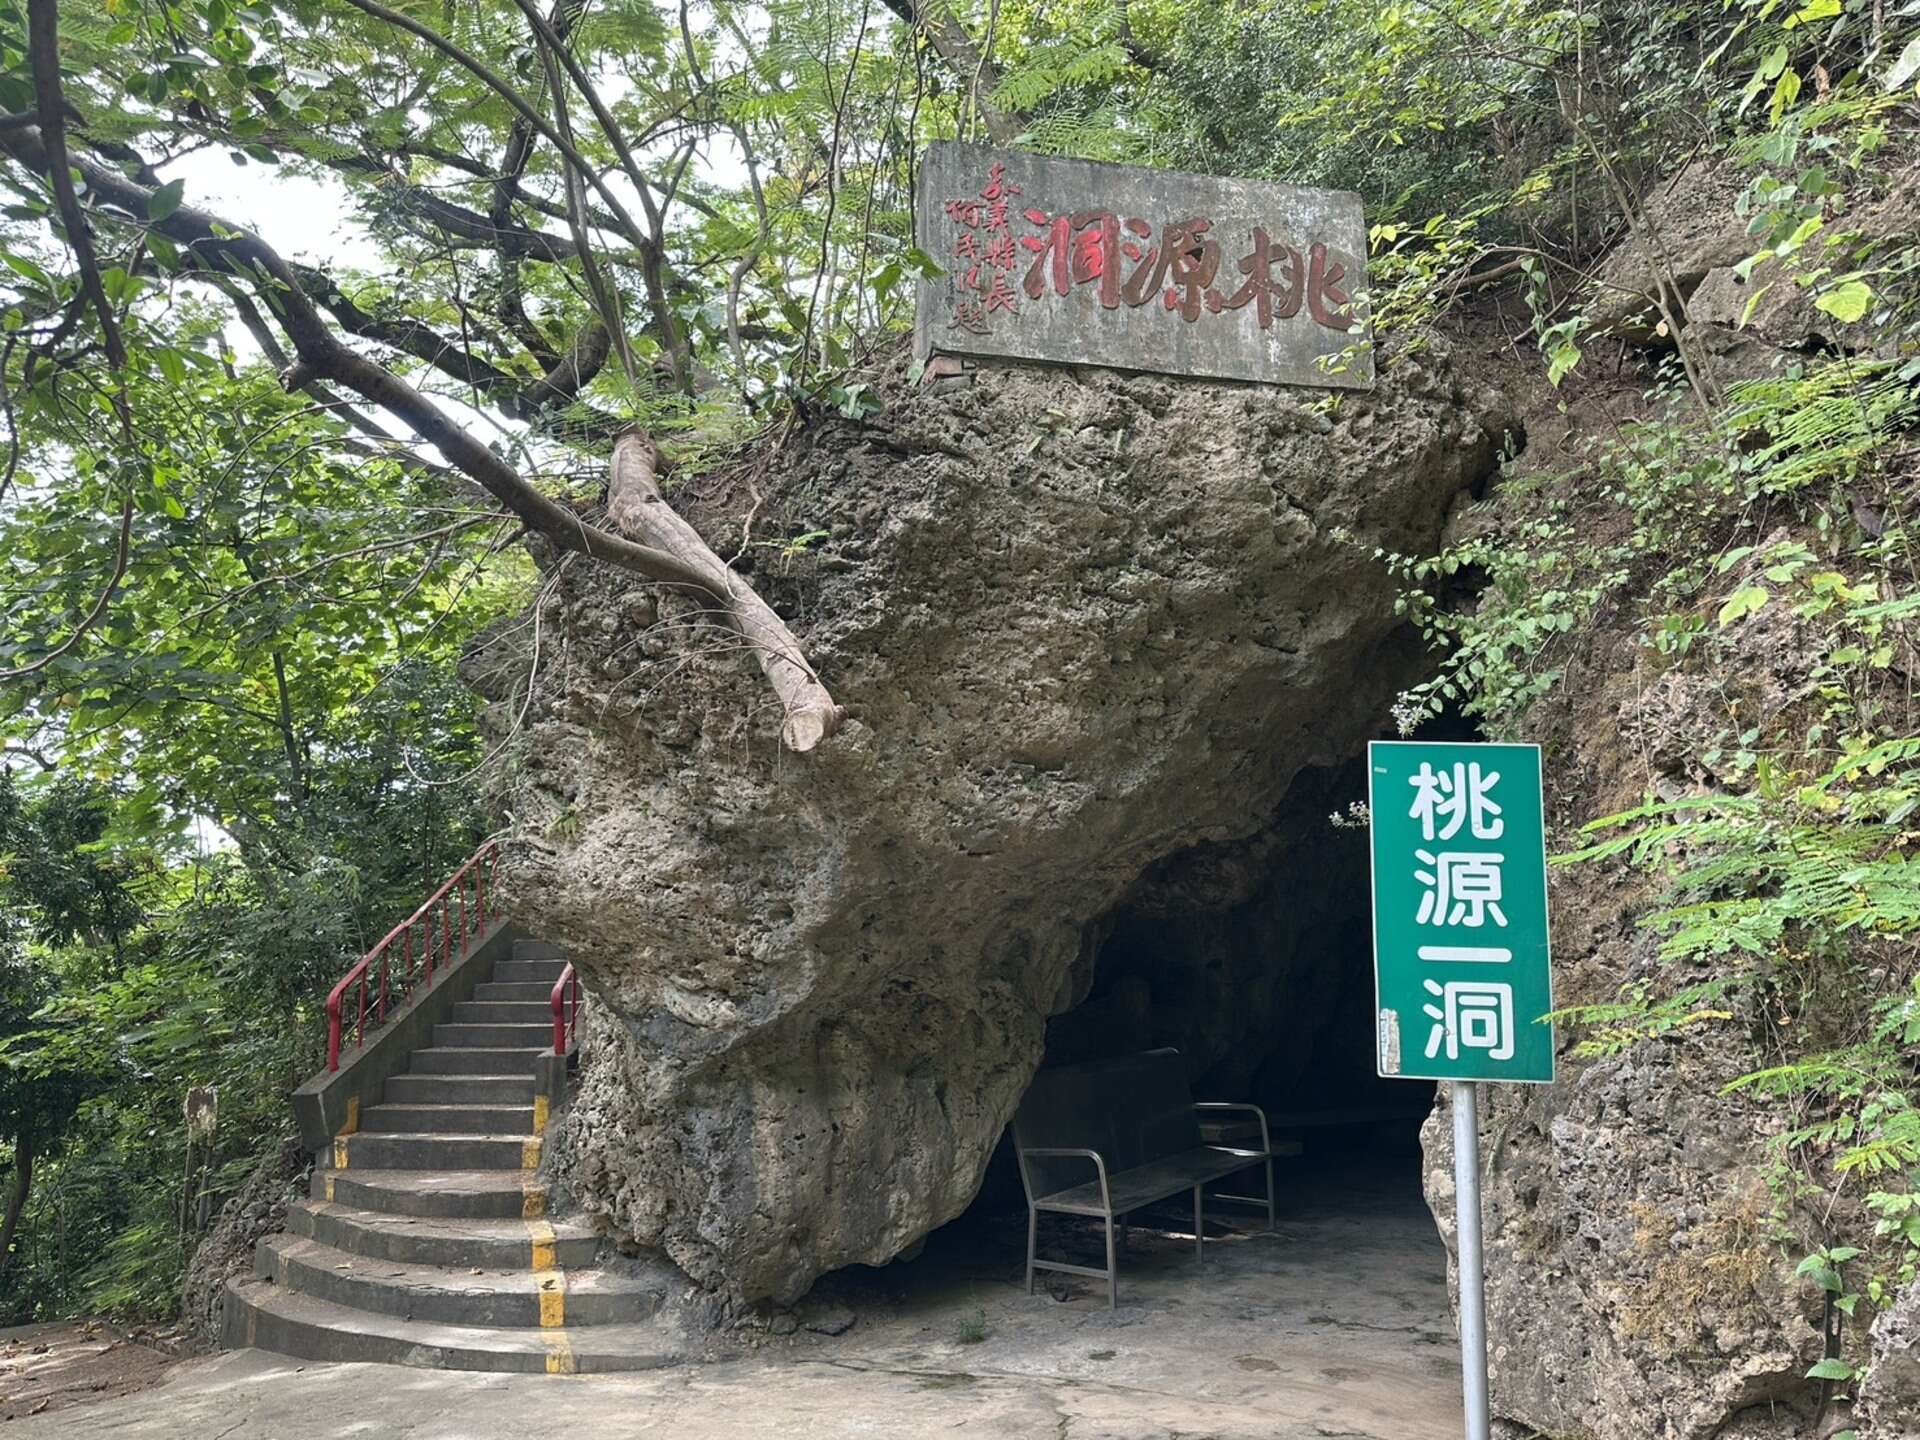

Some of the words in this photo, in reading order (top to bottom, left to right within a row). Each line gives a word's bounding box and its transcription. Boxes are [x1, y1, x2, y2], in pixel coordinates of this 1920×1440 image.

[1022, 208, 1355, 330] 桃源洞
[1408, 761, 1515, 1060] 桃源一洞
